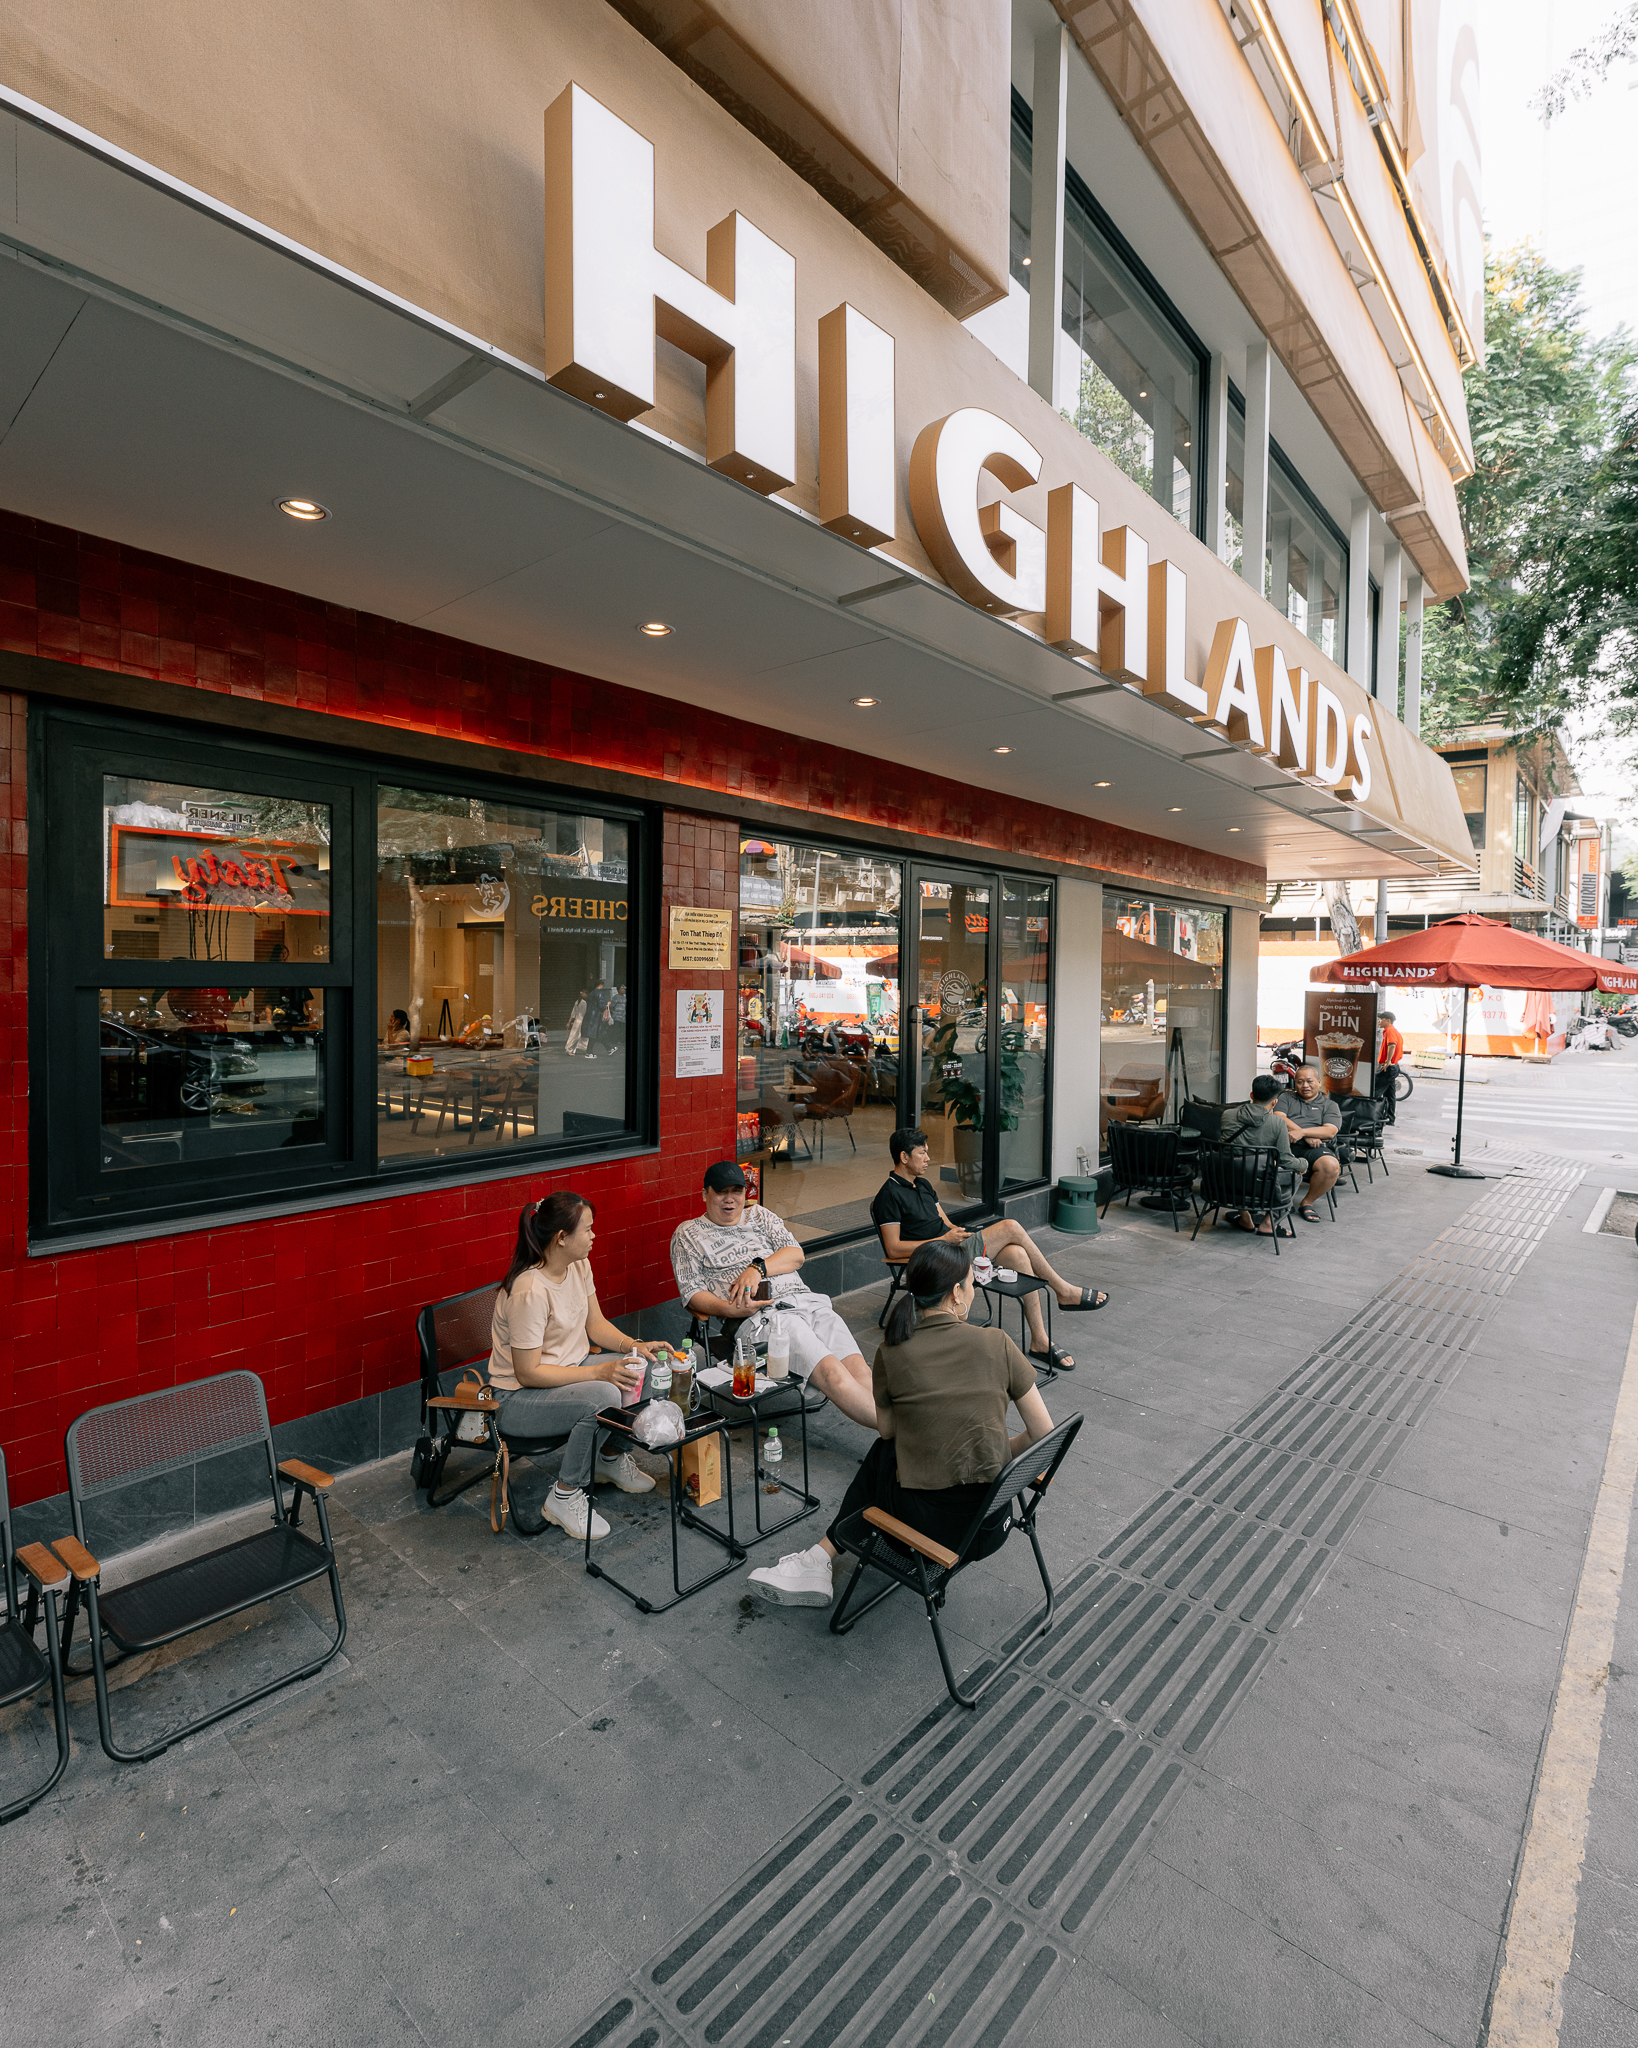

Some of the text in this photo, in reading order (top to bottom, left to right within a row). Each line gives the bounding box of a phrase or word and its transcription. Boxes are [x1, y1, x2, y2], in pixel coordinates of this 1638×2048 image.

[545, 80, 1372, 802] HIGHLANDS
[1588, 841, 1598, 873] SUPERMARKET
[1581, 873, 1597, 915] AKURUHI
[680, 929, 690, 937] Ton
[690, 930, 701, 938] That
[702, 930, 715, 939] Thiep
[939, 972, 971, 991] HIGHLANDS
[1343, 966, 1438, 978] HIGHLANDS
